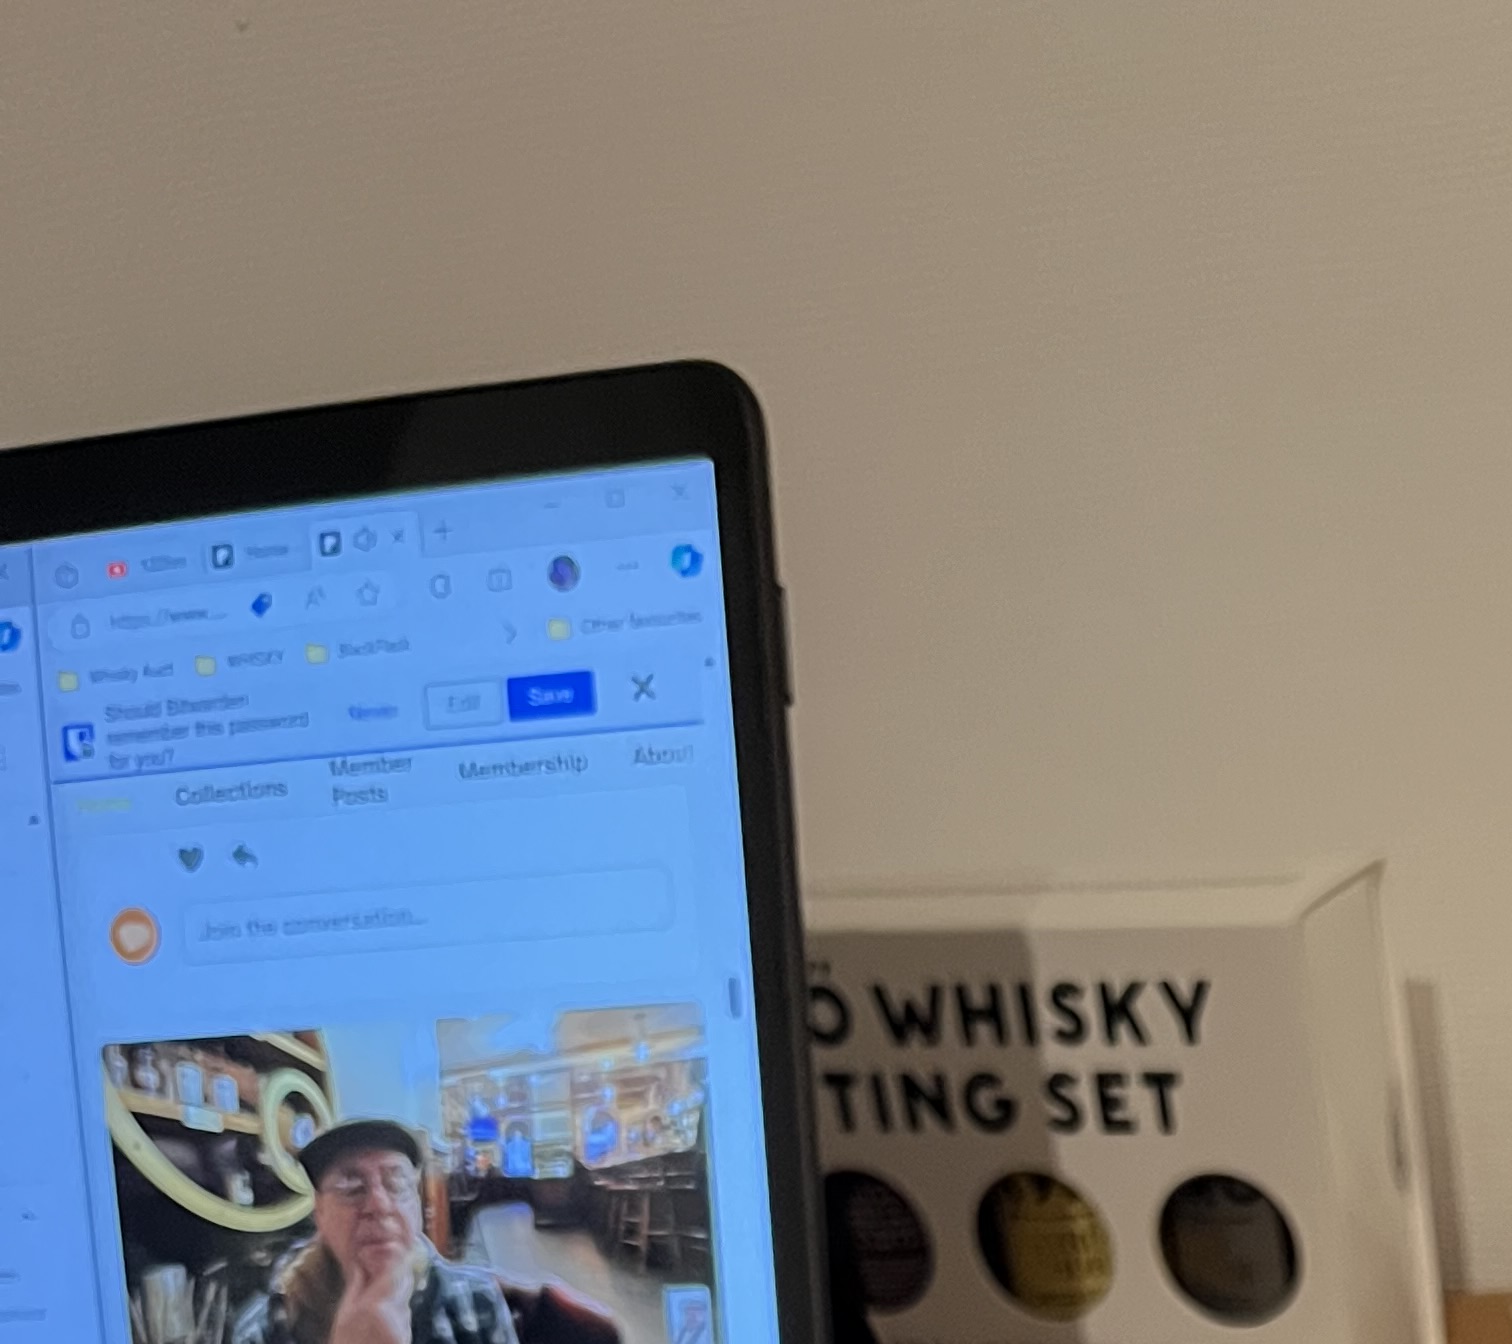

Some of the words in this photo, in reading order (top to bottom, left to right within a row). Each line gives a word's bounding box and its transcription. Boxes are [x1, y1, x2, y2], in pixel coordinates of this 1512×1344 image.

[328, 755, 413, 778] Member
[458, 753, 590, 783] Membership
[174, 779, 290, 808] Collections
[331, 785, 390, 807] Posts
[806, 984, 852, 1048] O
[866, 979, 1213, 1049] WHISKY
[822, 1070, 1020, 1136] TING
[1045, 1070, 1185, 1137] SET
